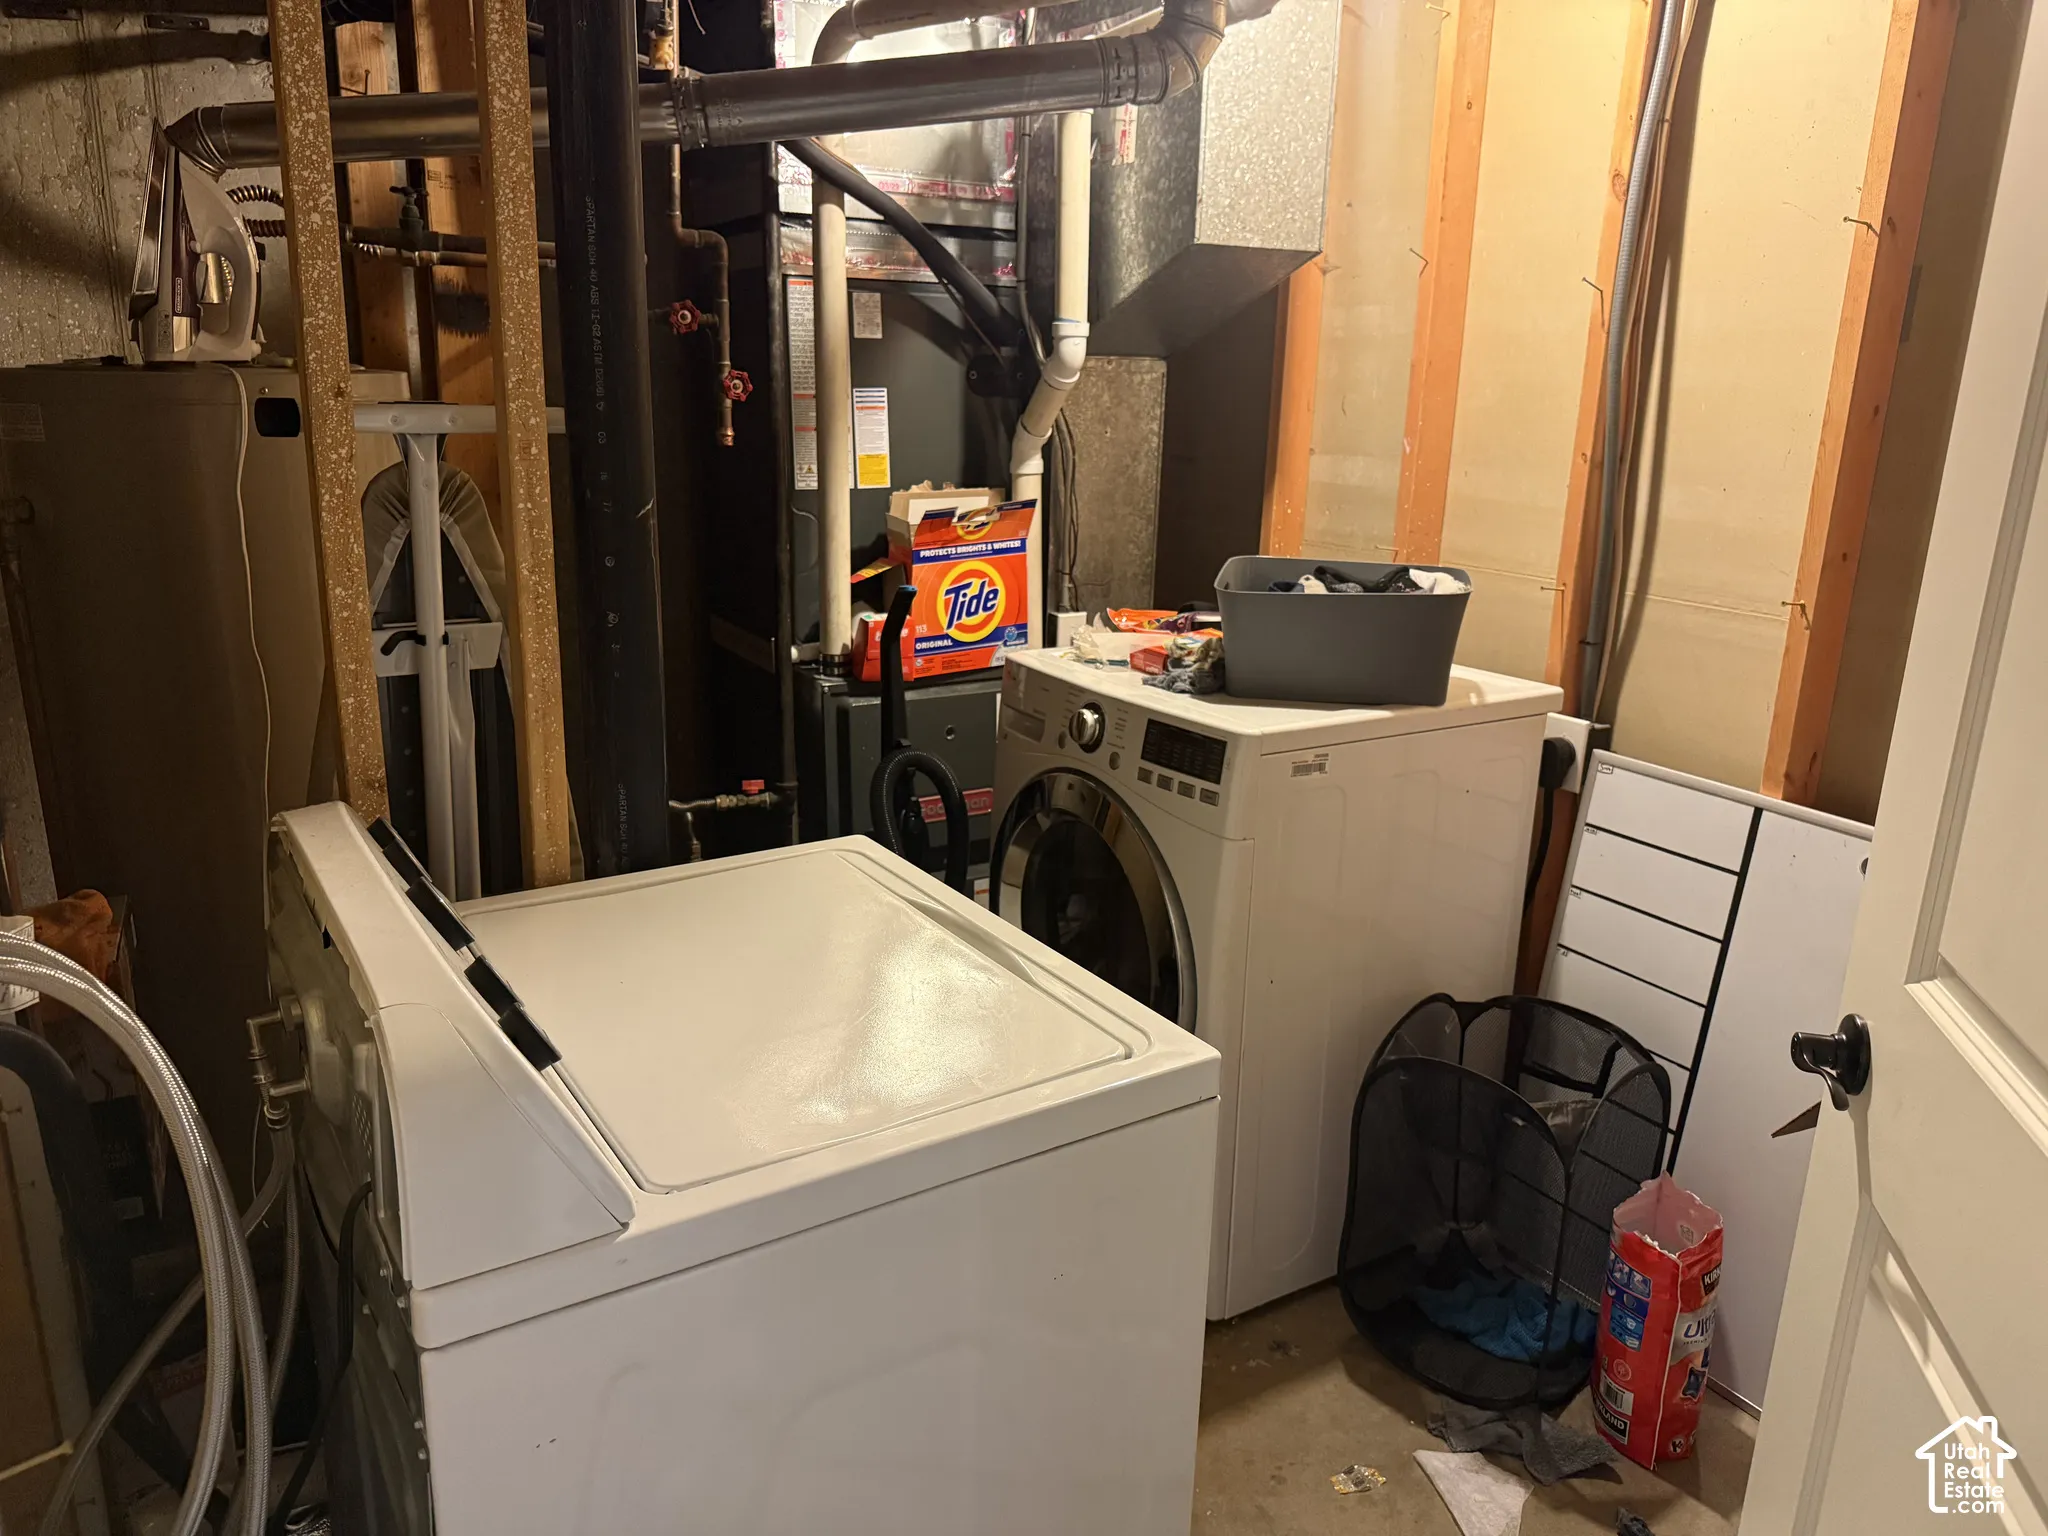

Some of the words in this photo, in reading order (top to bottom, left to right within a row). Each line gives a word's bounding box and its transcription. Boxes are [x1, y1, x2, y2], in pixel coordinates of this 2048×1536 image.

[585, 195, 597, 242] SPARTAN
[587, 244, 597, 265] SCH
[589, 267, 599, 282] 40
[590, 284, 600, 305] ABS
[919, 547, 956, 558] PROTECTS
[956, 544, 987, 554] BRIGHTS
[993, 540, 1021, 550] WHITES!
[943, 578, 1000, 632] Tide
[915, 638, 953, 650] ORIGINAL
